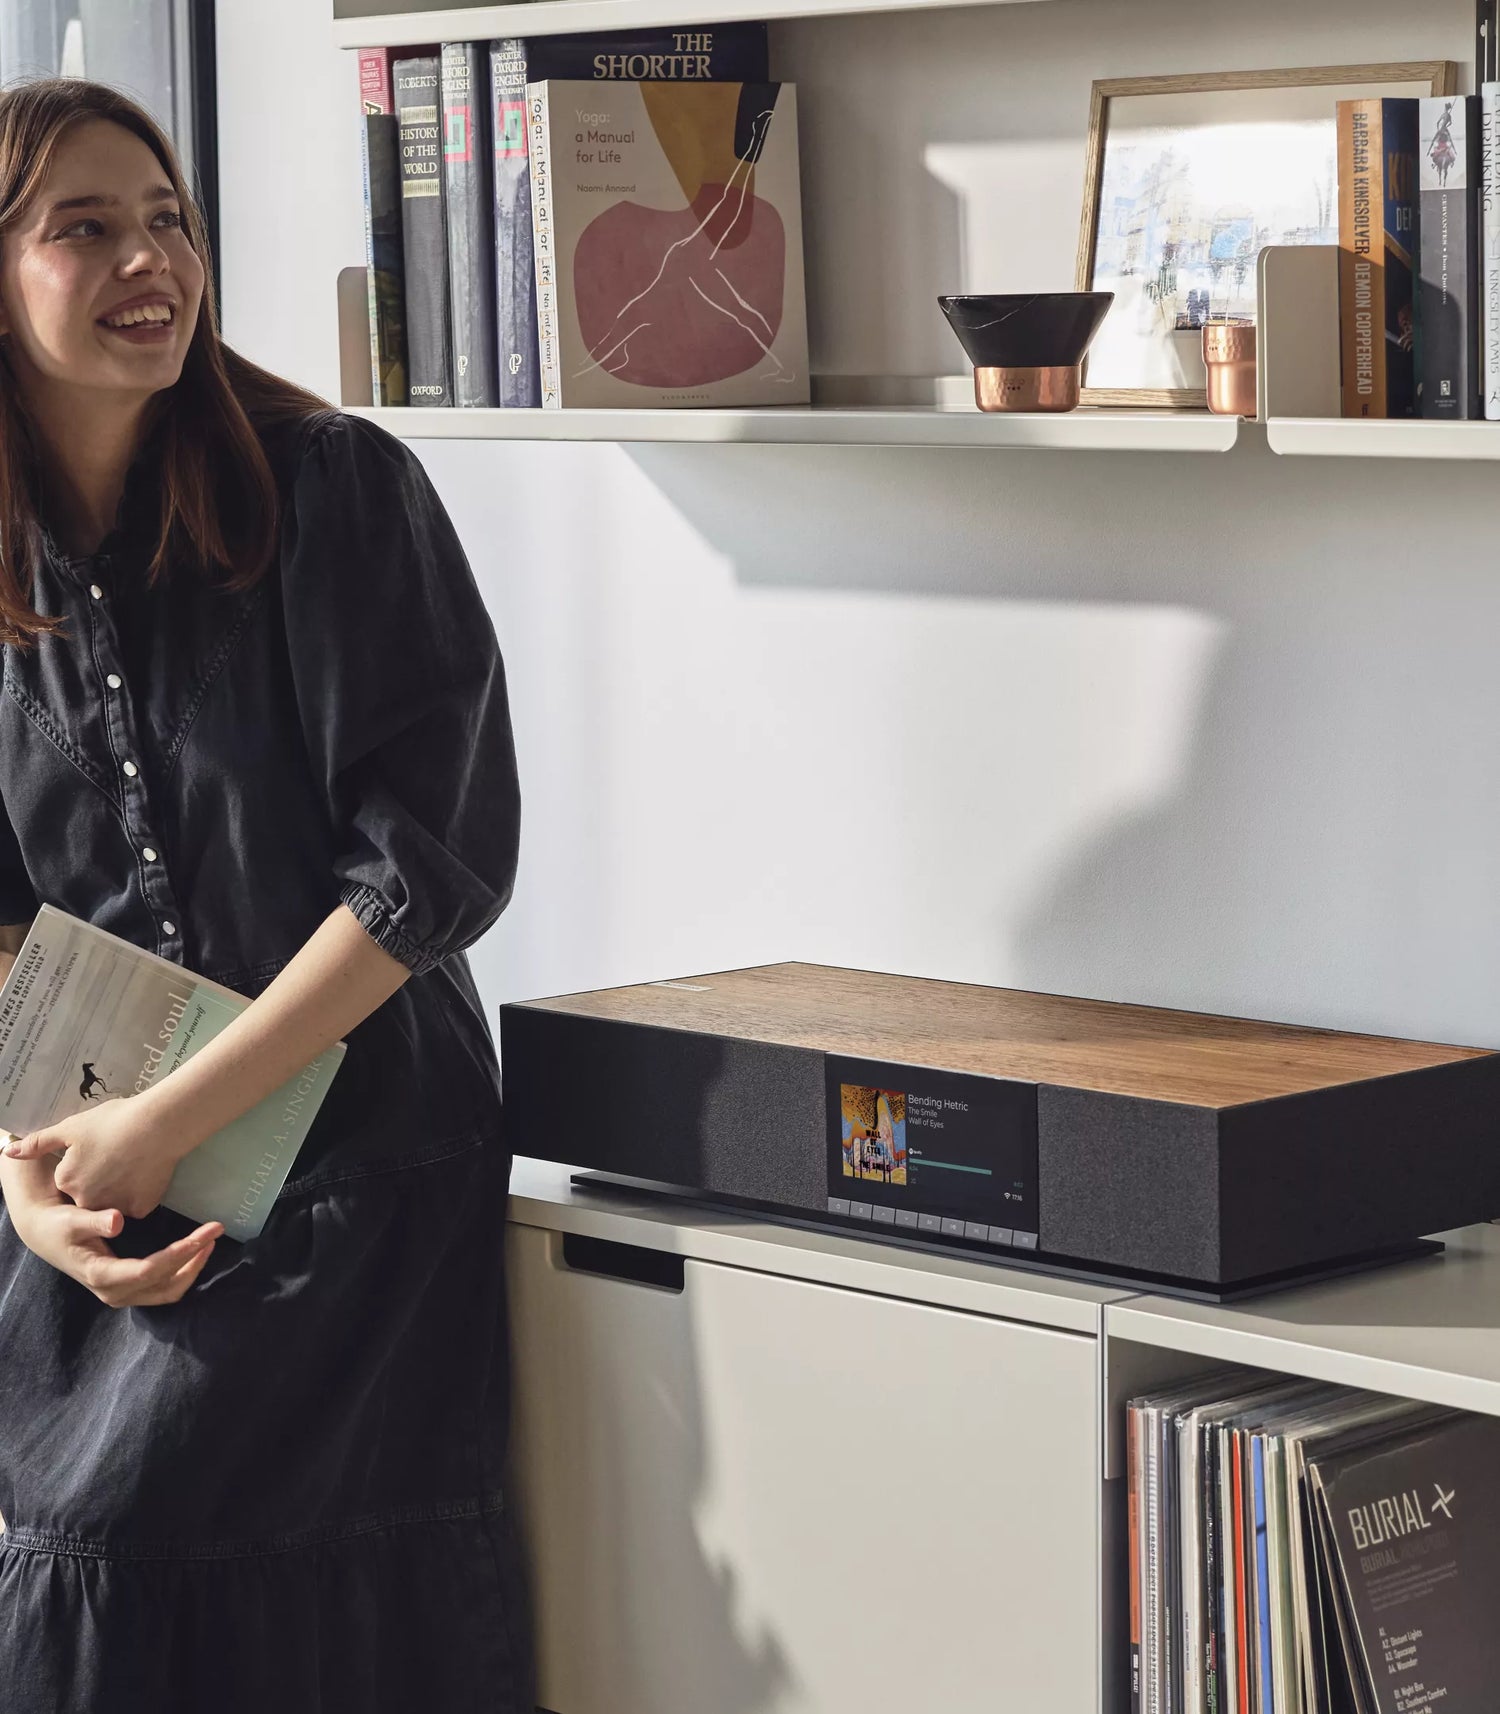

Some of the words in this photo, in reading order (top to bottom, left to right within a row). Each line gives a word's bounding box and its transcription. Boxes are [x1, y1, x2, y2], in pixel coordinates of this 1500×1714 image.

[672, 33, 713, 52] THE
[494, 61, 527, 74] OXFORD
[593, 54, 713, 79] SHORTER
[494, 74, 527, 87] ENGLISH
[575, 109, 611, 127] Yoga:
[400, 126, 439, 141] HISTORY
[575, 134, 583, 143] a
[587, 130, 635, 144] Manual
[403, 146, 414, 157] OF
[416, 144, 437, 156] THE
[1352, 113, 1369, 174] BARBARA
[575, 149, 594, 163] for
[598, 149, 621, 163] Life
[403, 162, 437, 174] WORLD
[576, 183, 603, 193] Naomi
[605, 183, 636, 193] Annand
[1353, 177, 1370, 255] KINGSOLVER
[1354, 263, 1371, 308] DEMON
[1355, 312, 1372, 395] COPPERHEAD
[411, 385, 442, 396] OXFORD
[12, 943, 42, 996] BESTSELLER
[8, 1000, 24, 1027] MILLION
[21, 975, 36, 999] COPIES
[32, 956, 45, 973] SOLD
[158, 991, 190, 1043] soul
[174, 1031, 192, 1059] beyond
[908, 1094, 942, 1110] Bending
[908, 1106, 920, 1116] The
[920, 1107, 938, 1118] Smile
[908, 1116, 922, 1126] Wall
[922, 1118, 929, 1127] of
[929, 1119, 944, 1129] Eyes
[233, 1151, 280, 1228] MICHAEL
[273, 1131, 289, 1147] A.
[282, 1058, 324, 1126] SINGER
[1348, 1489, 1431, 1550] BURIAL
